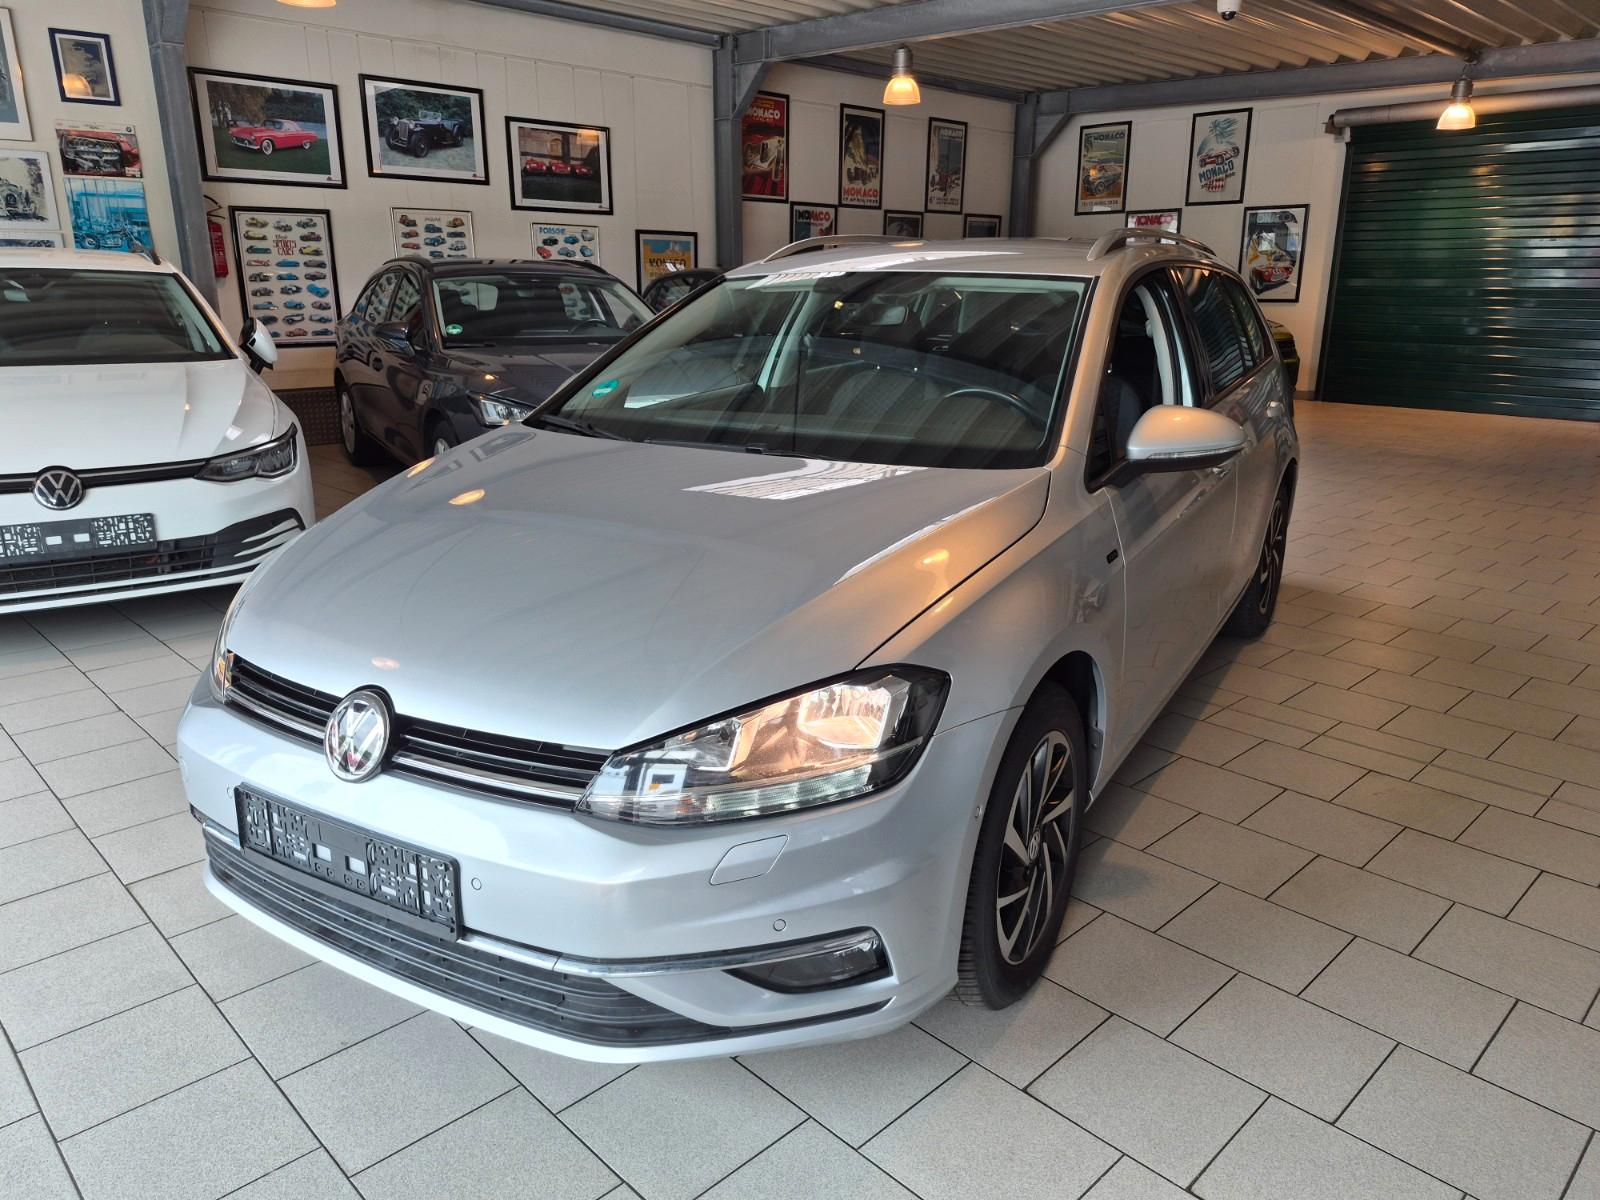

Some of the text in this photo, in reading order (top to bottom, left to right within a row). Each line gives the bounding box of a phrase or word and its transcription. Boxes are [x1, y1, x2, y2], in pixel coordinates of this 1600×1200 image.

[1092, 131, 1125, 141] MONACO
[1199, 160, 1234, 182] MONACO
[843, 185, 879, 199] MONACO
[797, 210, 831, 222] MONACO
[273, 240, 297, 248] SPORTS
[278, 247, 294, 256] CARS
